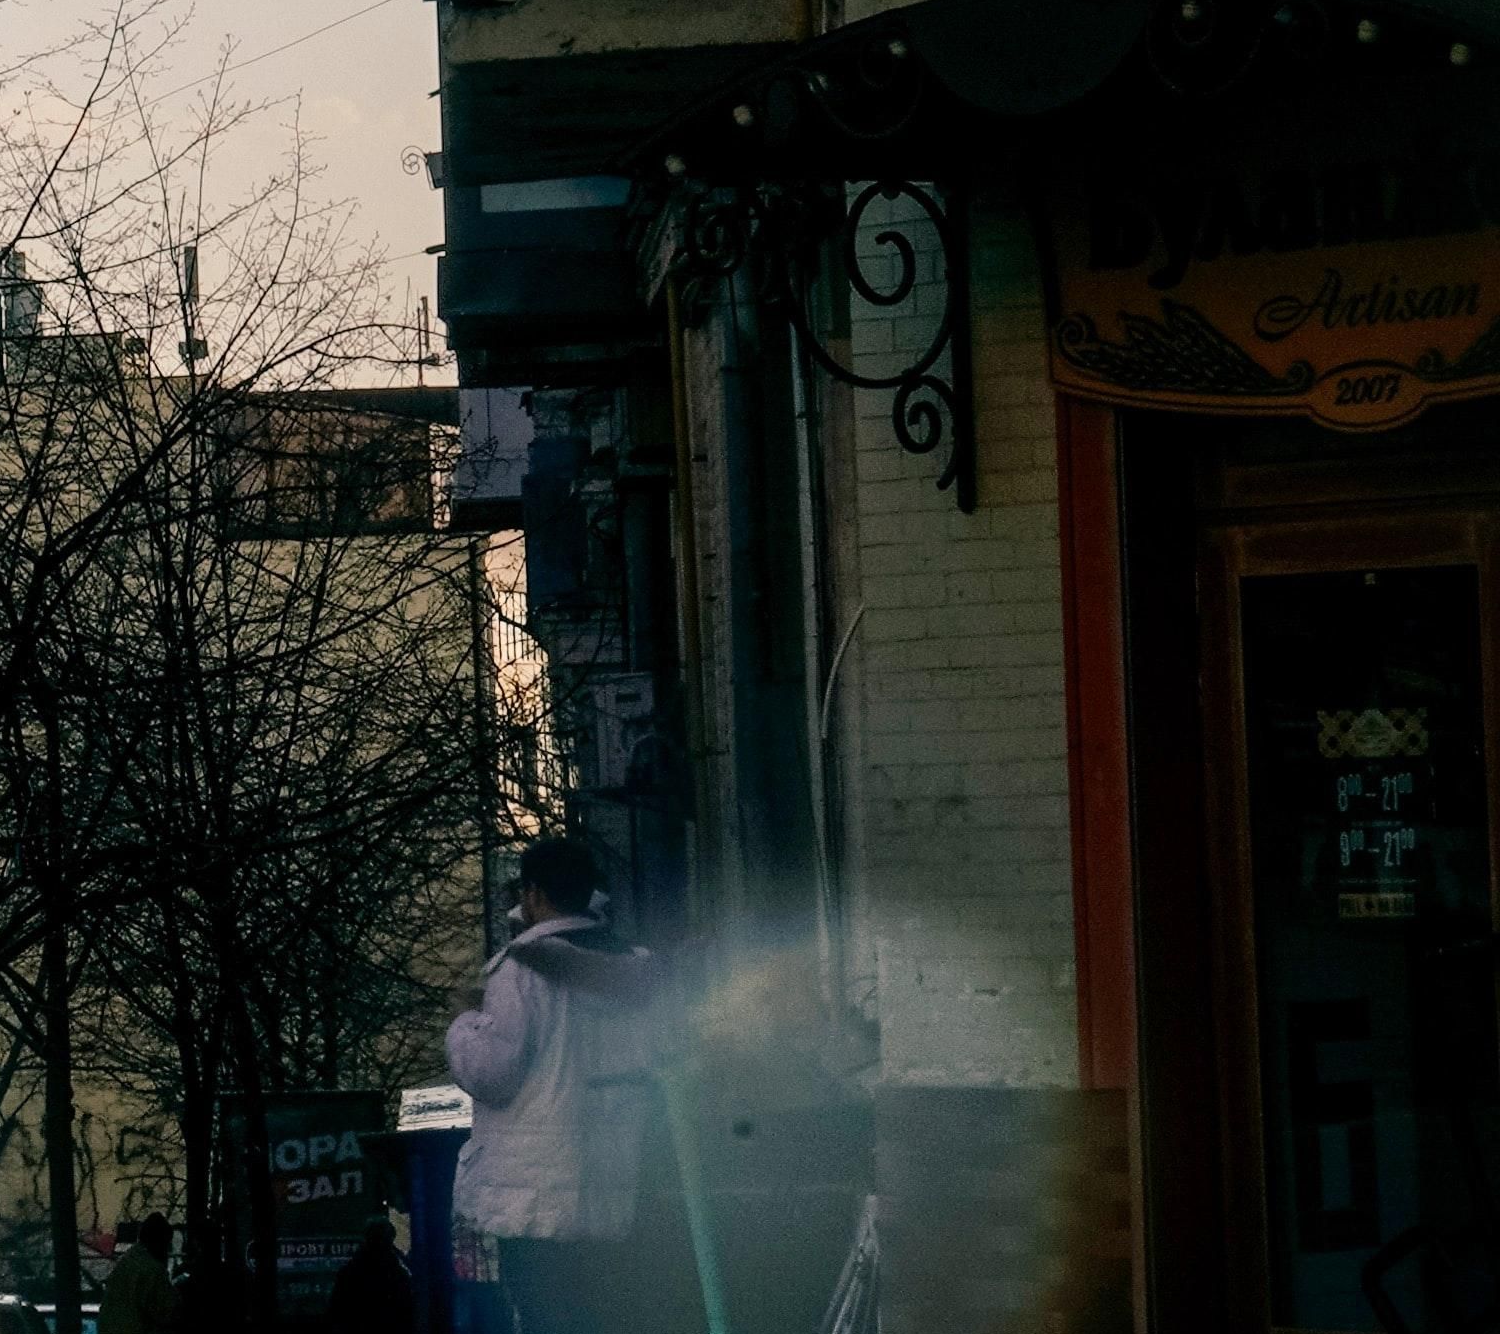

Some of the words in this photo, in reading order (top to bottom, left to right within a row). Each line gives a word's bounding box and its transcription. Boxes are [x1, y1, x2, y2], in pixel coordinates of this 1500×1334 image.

[1254, 268, 1480, 341] Artisan
[1336, 375, 1400, 406] 2007
[286, 1169, 363, 1205] ЗАЛ
